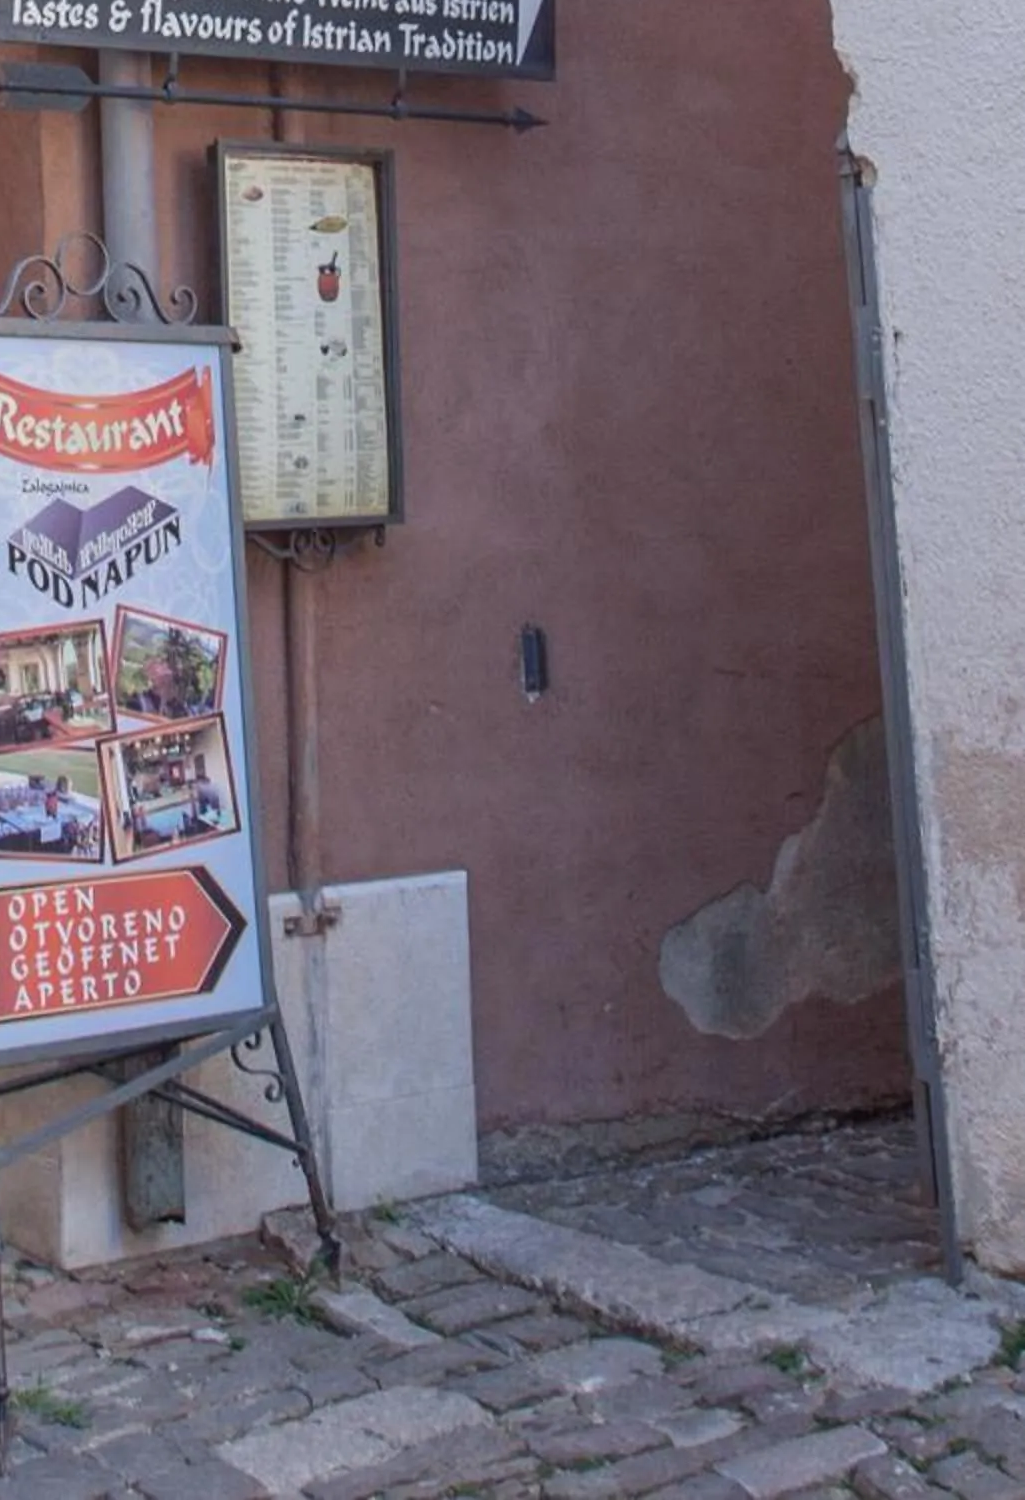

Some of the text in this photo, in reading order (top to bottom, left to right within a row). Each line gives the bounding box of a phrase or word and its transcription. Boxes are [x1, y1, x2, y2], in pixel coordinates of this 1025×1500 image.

[268, 8, 299, 46] of
[302, 13, 391, 53] Istrian
[398, 23, 514, 65] Tradition
[7, 541, 74, 609] POD
[82, 516, 182, 609] NAPUN
[8, 886, 95, 920] OPEN
[9, 905, 185, 951] OTVORENO
[14, 969, 141, 1011] APERTO
